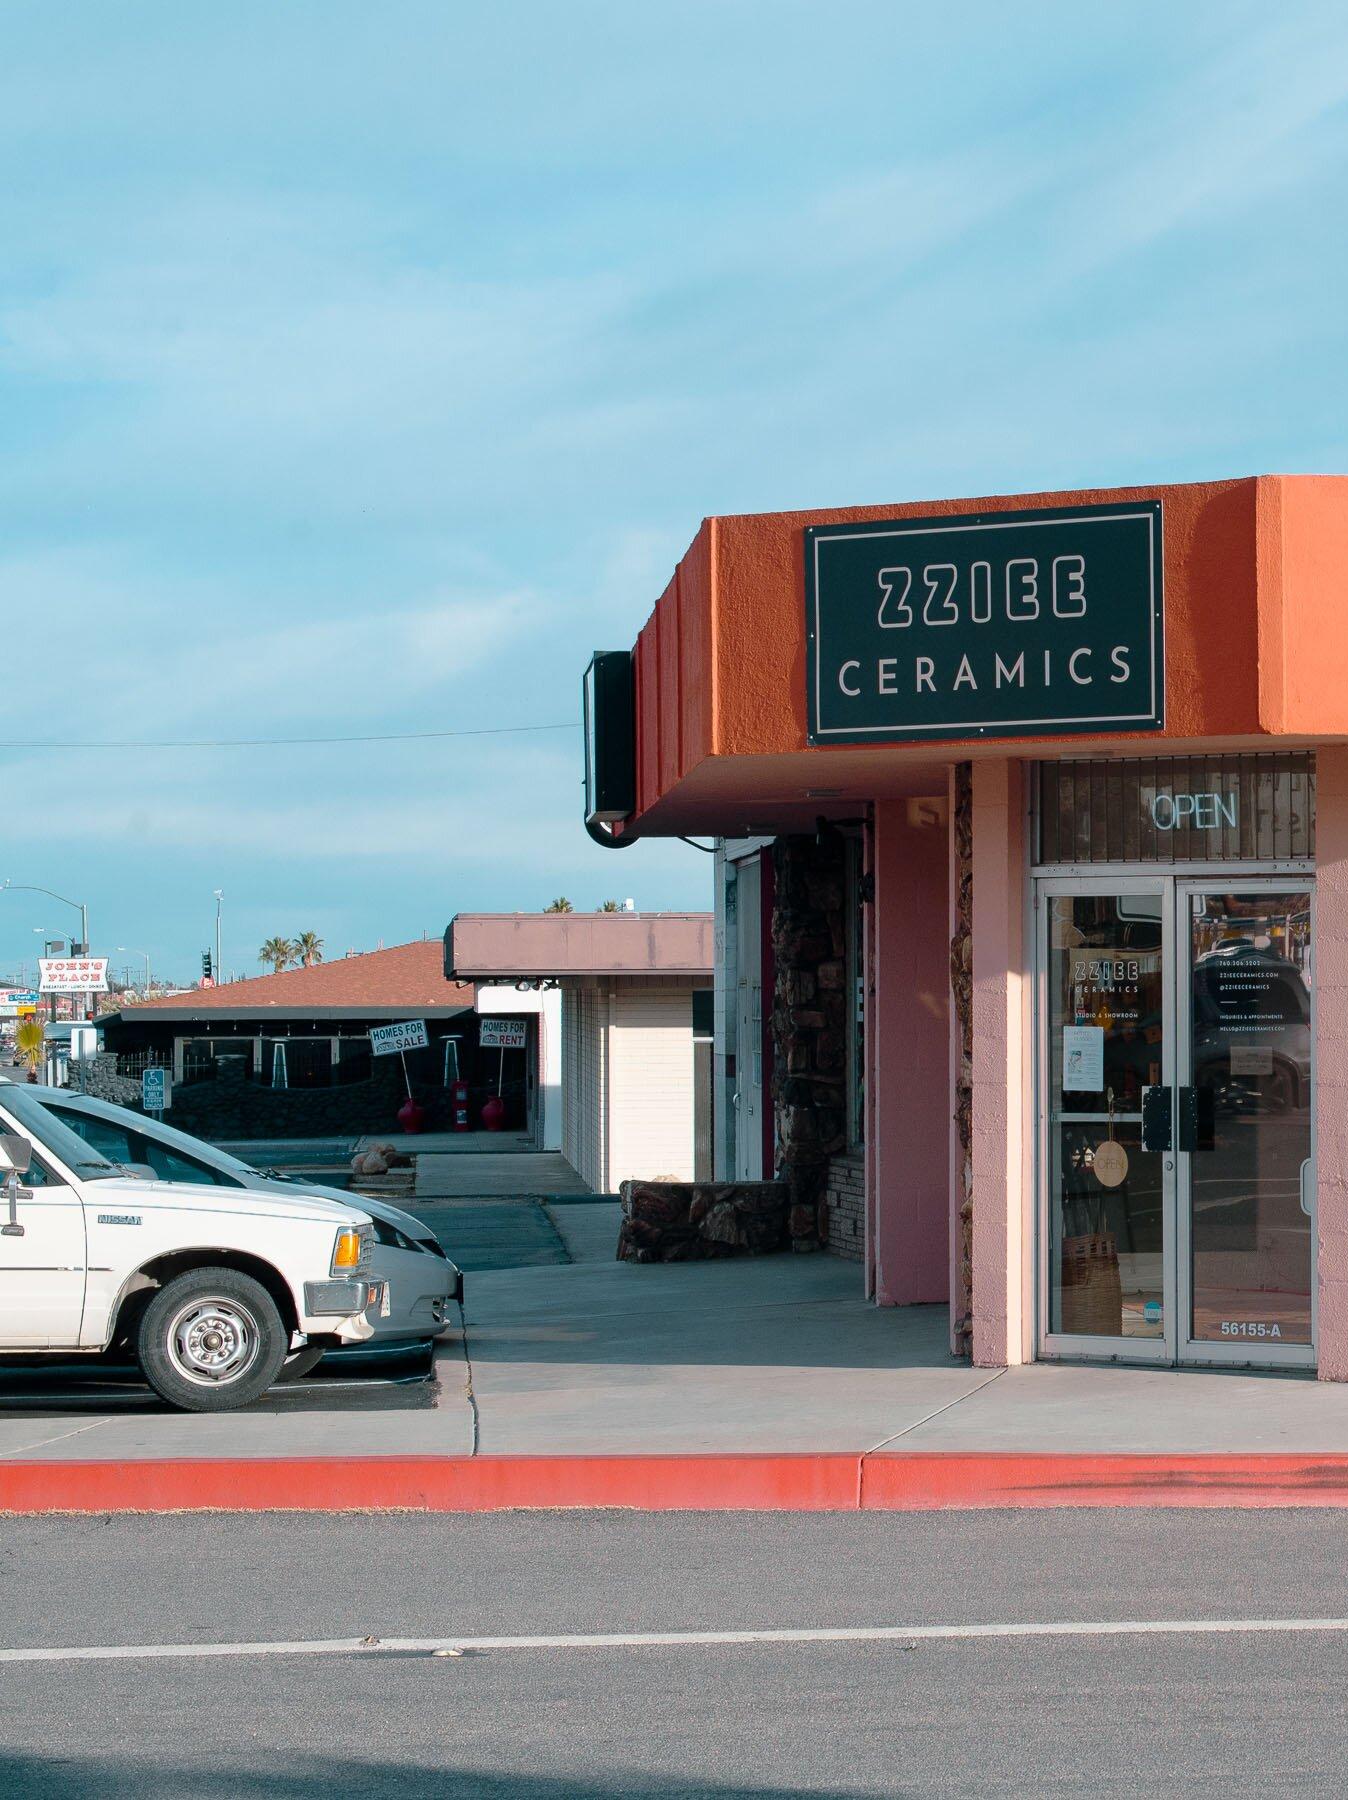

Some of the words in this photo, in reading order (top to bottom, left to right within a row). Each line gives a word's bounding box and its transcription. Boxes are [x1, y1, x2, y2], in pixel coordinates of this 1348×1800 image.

[877, 554, 1087, 629] ZZIEE
[838, 646, 1131, 696] CERAMICS
[1152, 792, 1236, 831] OPEN
[45, 962, 103, 971] JOHN'S
[1075, 961, 1139, 980] ZZIEE
[48, 973, 101, 982] PLACE
[372, 1024, 404, 1041] HOMES
[405, 1022, 424, 1035] FOR
[482, 1021, 508, 1033] HOMES
[509, 1021, 525, 1033] FOR
[395, 1034, 425, 1050] SALE
[499, 1035, 523, 1045] RENT
[97, 1215, 142, 1225] NISSAN
[1221, 1322, 1282, 1337] 56155-A
